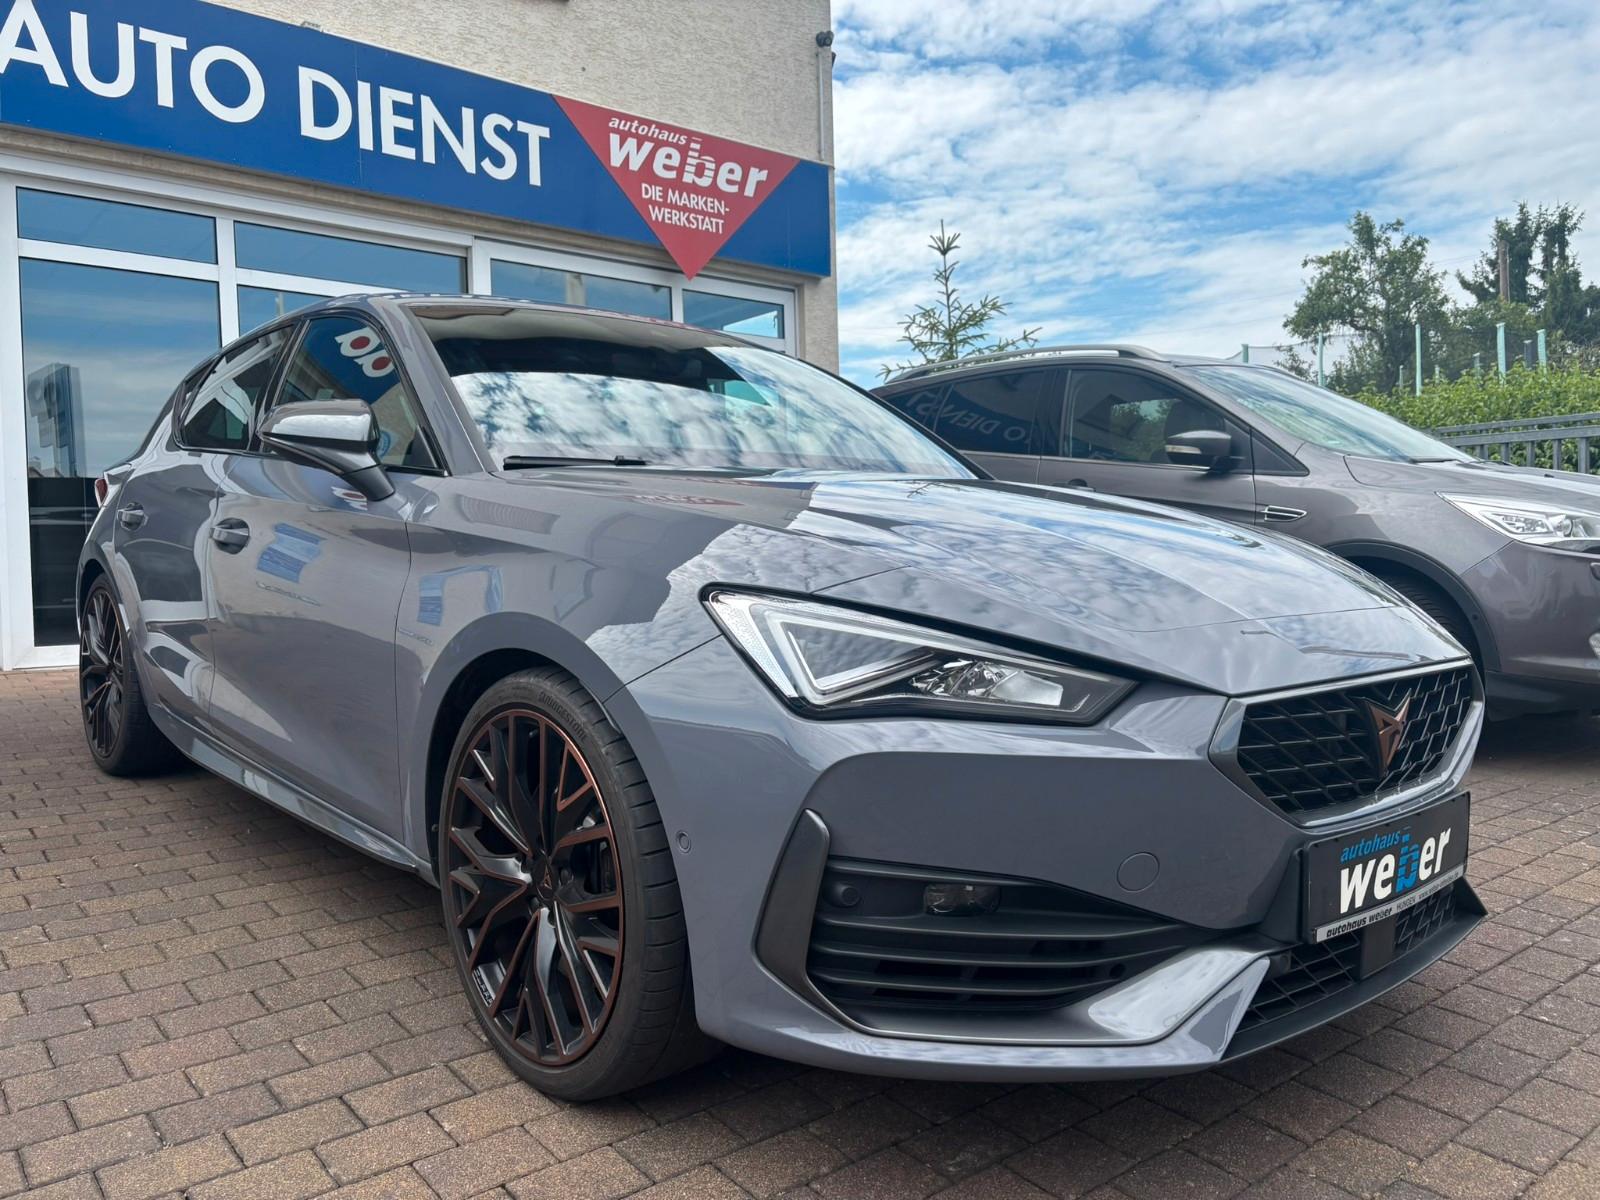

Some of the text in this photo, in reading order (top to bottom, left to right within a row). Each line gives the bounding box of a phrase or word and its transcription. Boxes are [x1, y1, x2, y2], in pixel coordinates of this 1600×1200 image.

[0, 0, 550, 186] AUTO DIENST
[608, 117, 688, 145] autohaus
[609, 133, 768, 197] weber
[641, 183, 730, 215] DIE MARKEN-
[648, 205, 724, 234] WERKSTATT
[1340, 831, 1401, 863] autohaus
[1340, 826, 1451, 914] weber
[1326, 917, 1367, 938] autohaus
